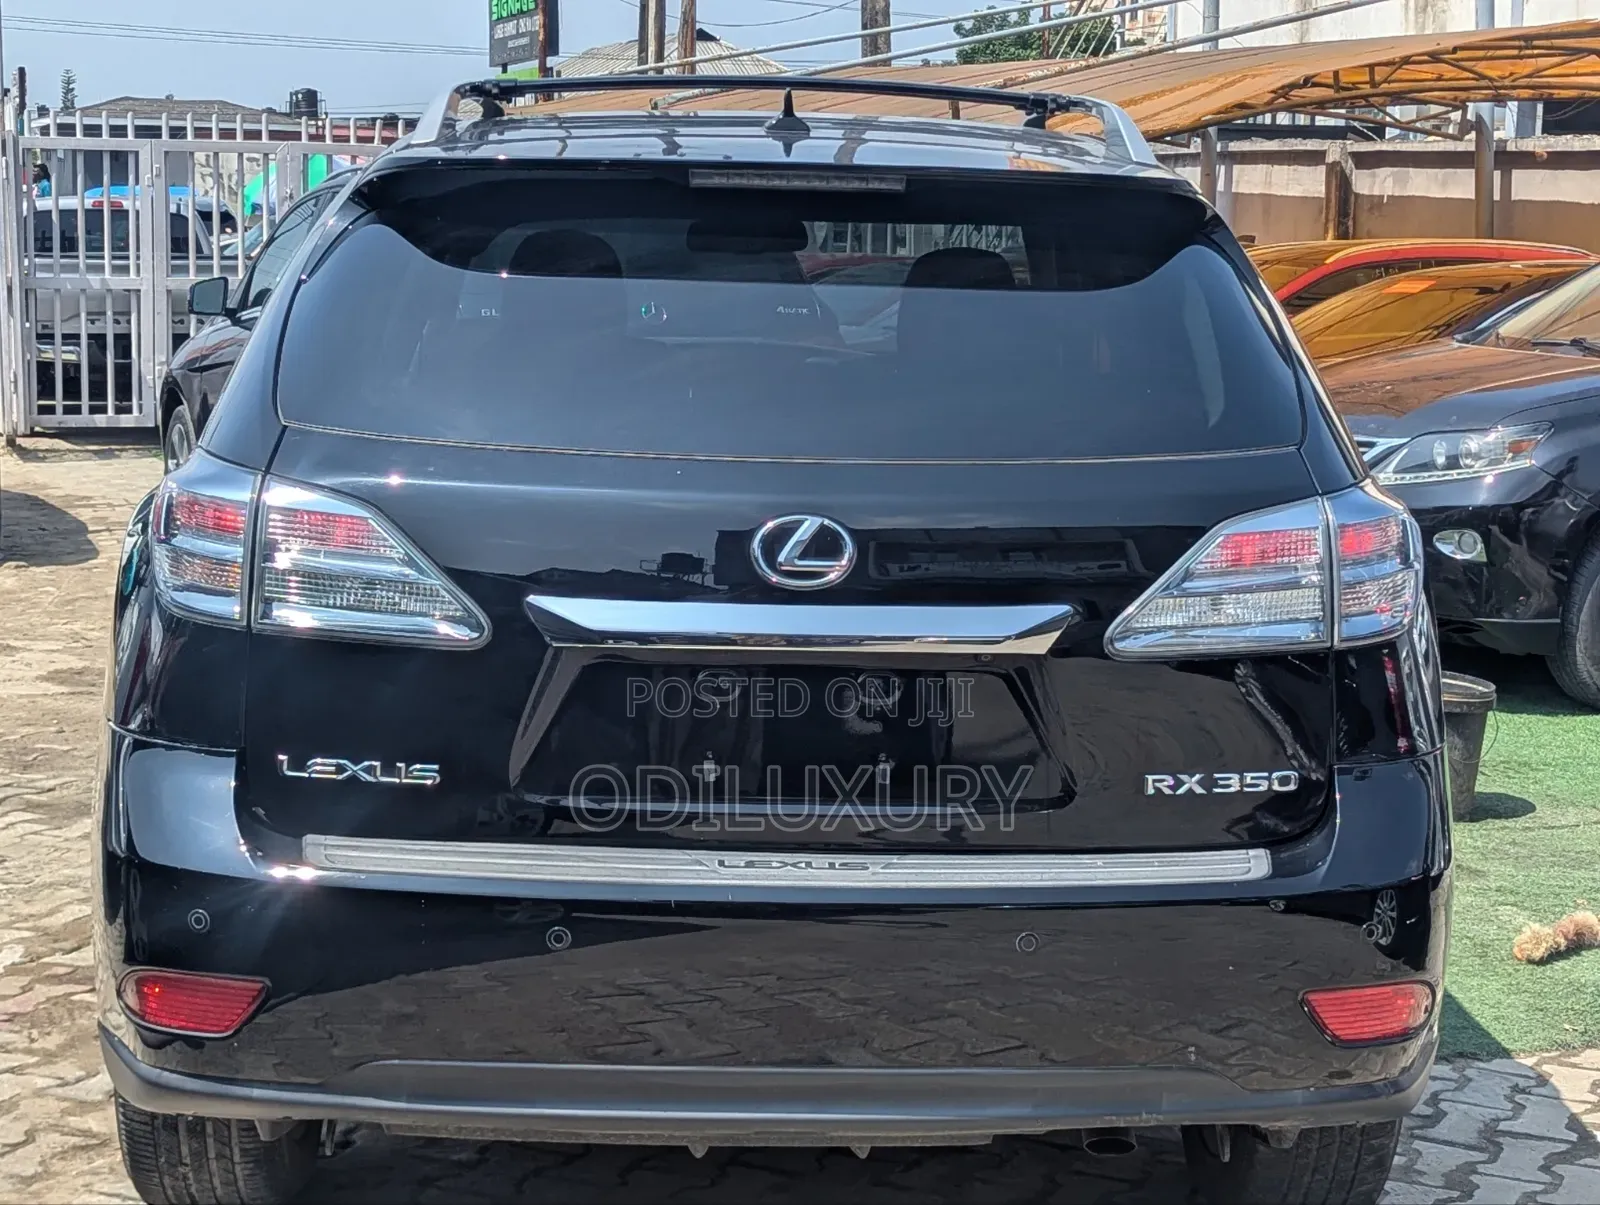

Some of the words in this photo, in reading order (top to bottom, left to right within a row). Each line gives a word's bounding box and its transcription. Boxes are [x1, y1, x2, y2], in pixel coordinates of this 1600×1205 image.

[277, 754, 441, 785] LEXUS
[1144, 773, 1207, 796] RX
[1212, 771, 1299, 793] 350
[717, 859, 870, 871] LEXUS
